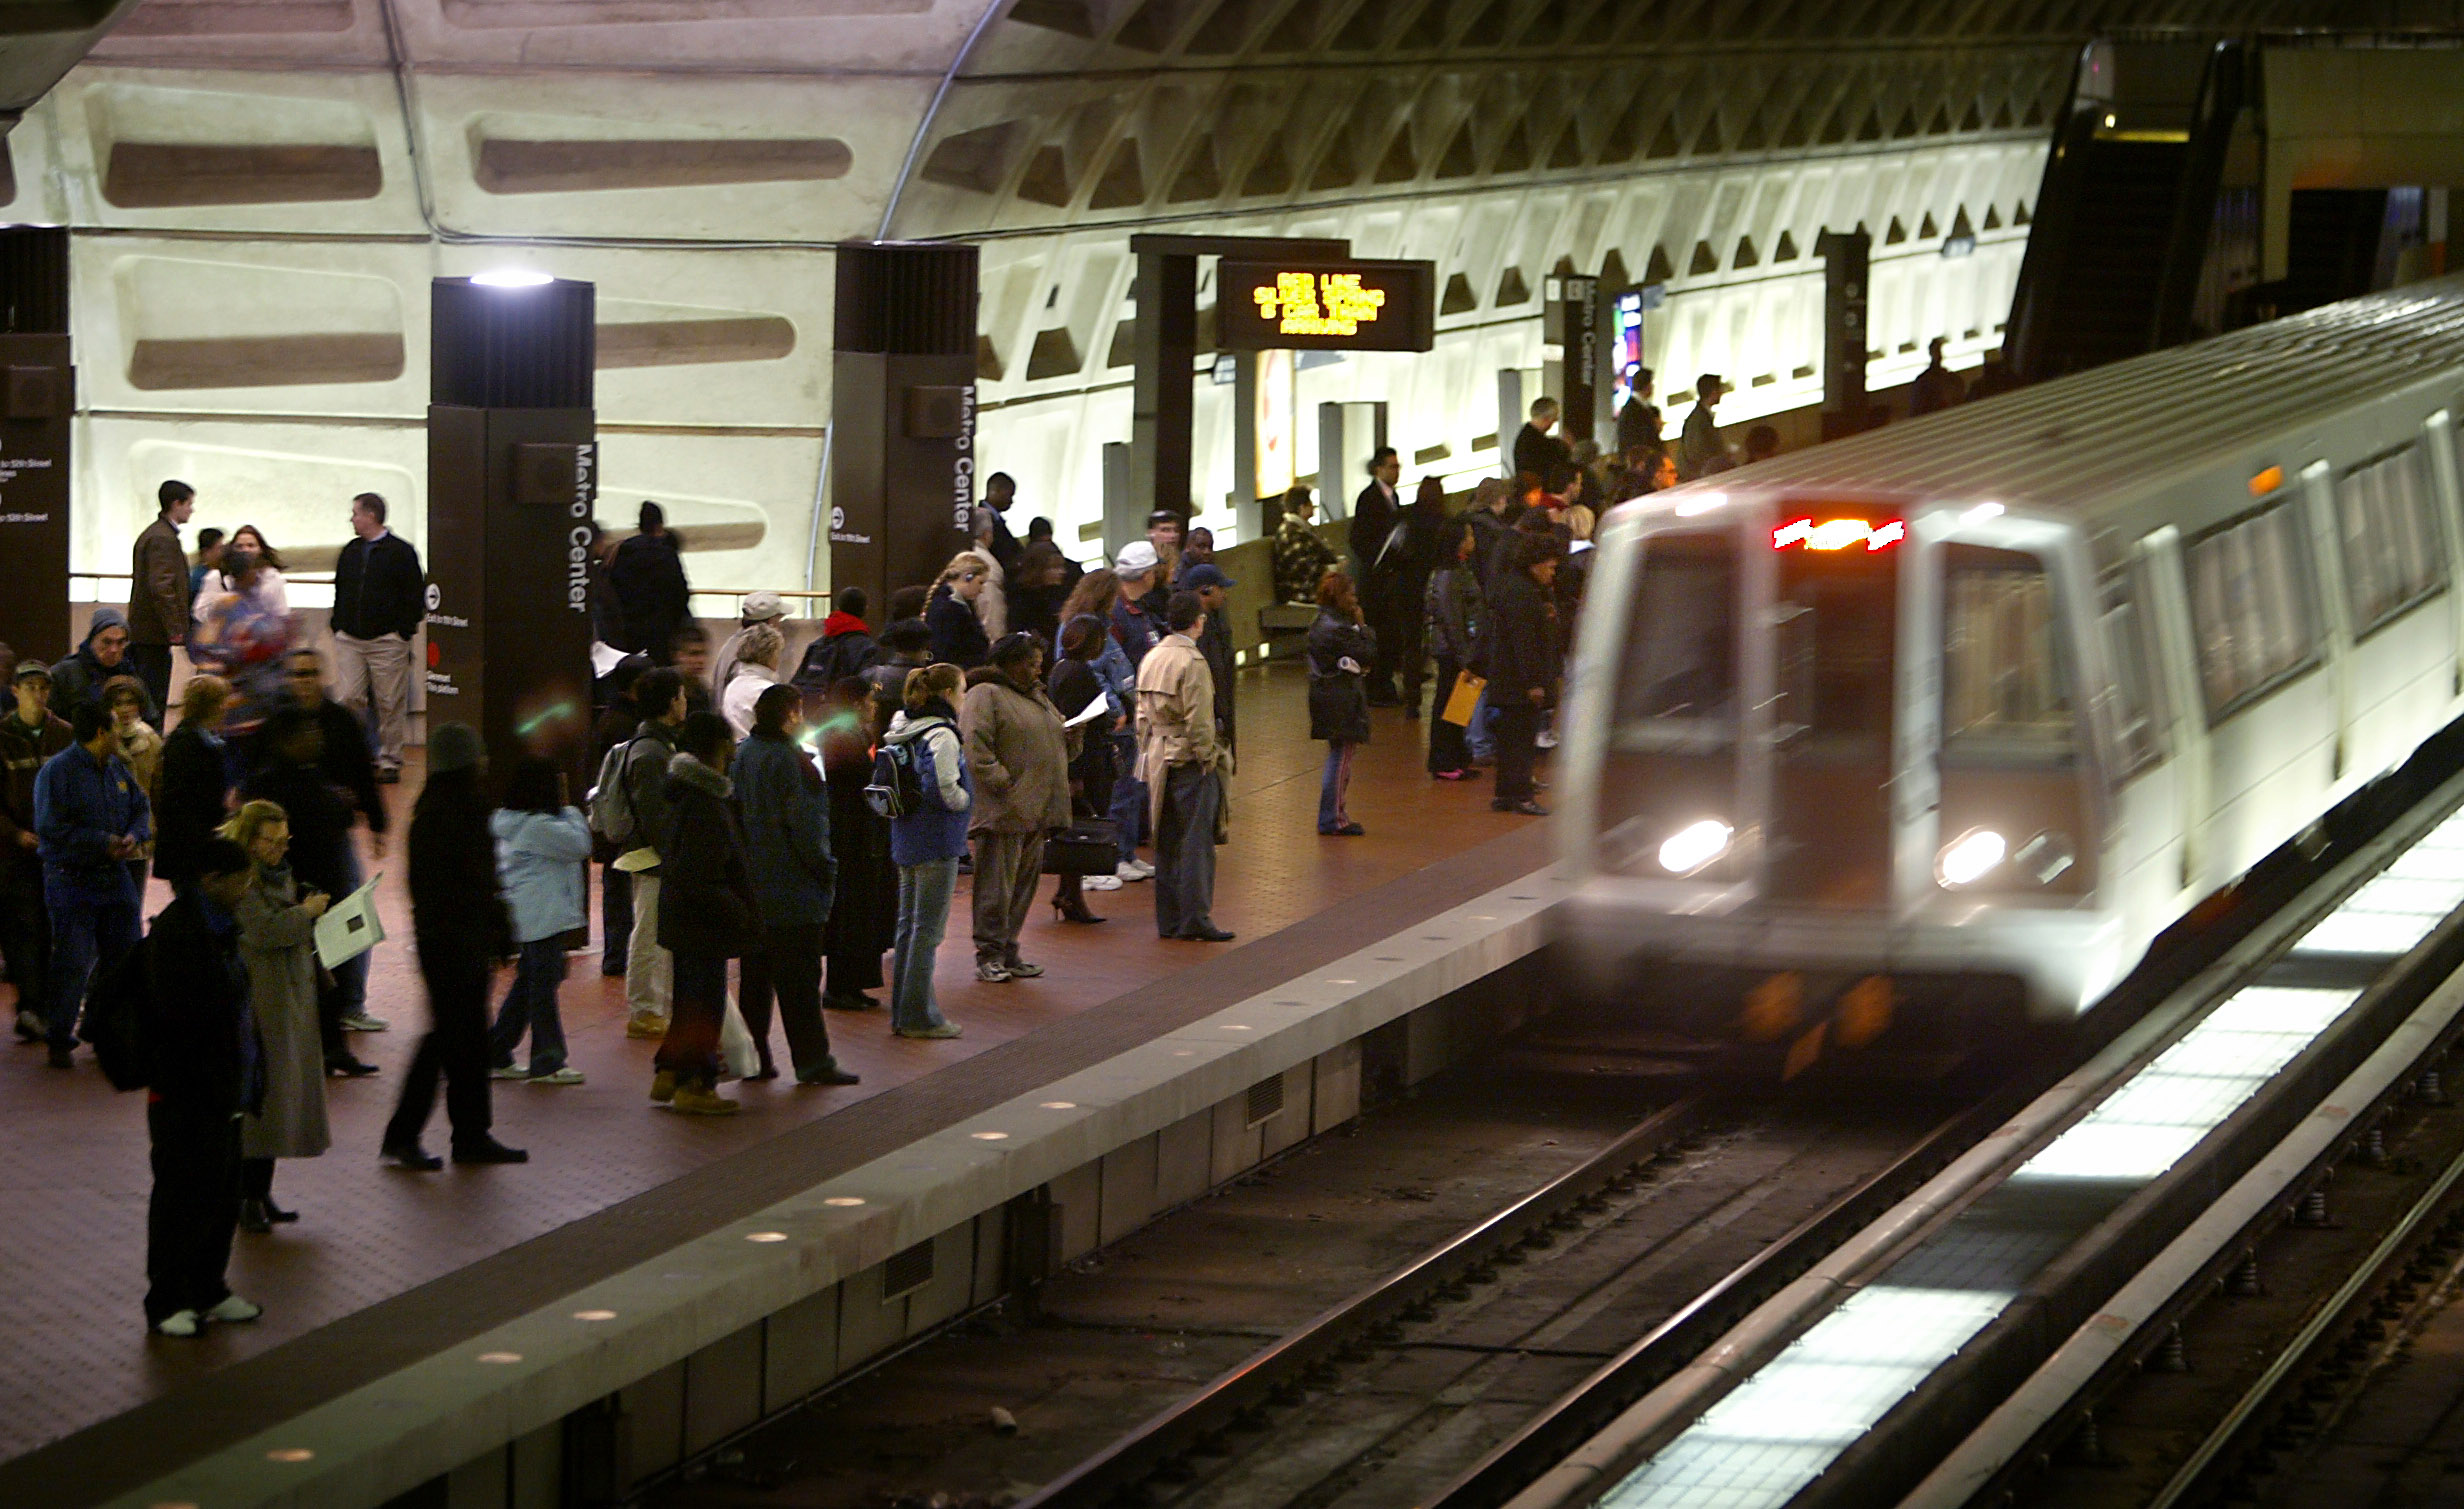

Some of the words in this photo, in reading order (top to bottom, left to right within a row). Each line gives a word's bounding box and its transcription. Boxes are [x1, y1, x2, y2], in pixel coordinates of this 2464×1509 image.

[1253, 287, 1316, 304] SILVER
[1277, 272, 1315, 289] RED
[1320, 274, 1361, 290] LINE
[955, 386, 974, 450] Metro
[571, 444, 593, 518] Metro
[954, 457, 974, 532] Center
[569, 526, 593, 613] Center
